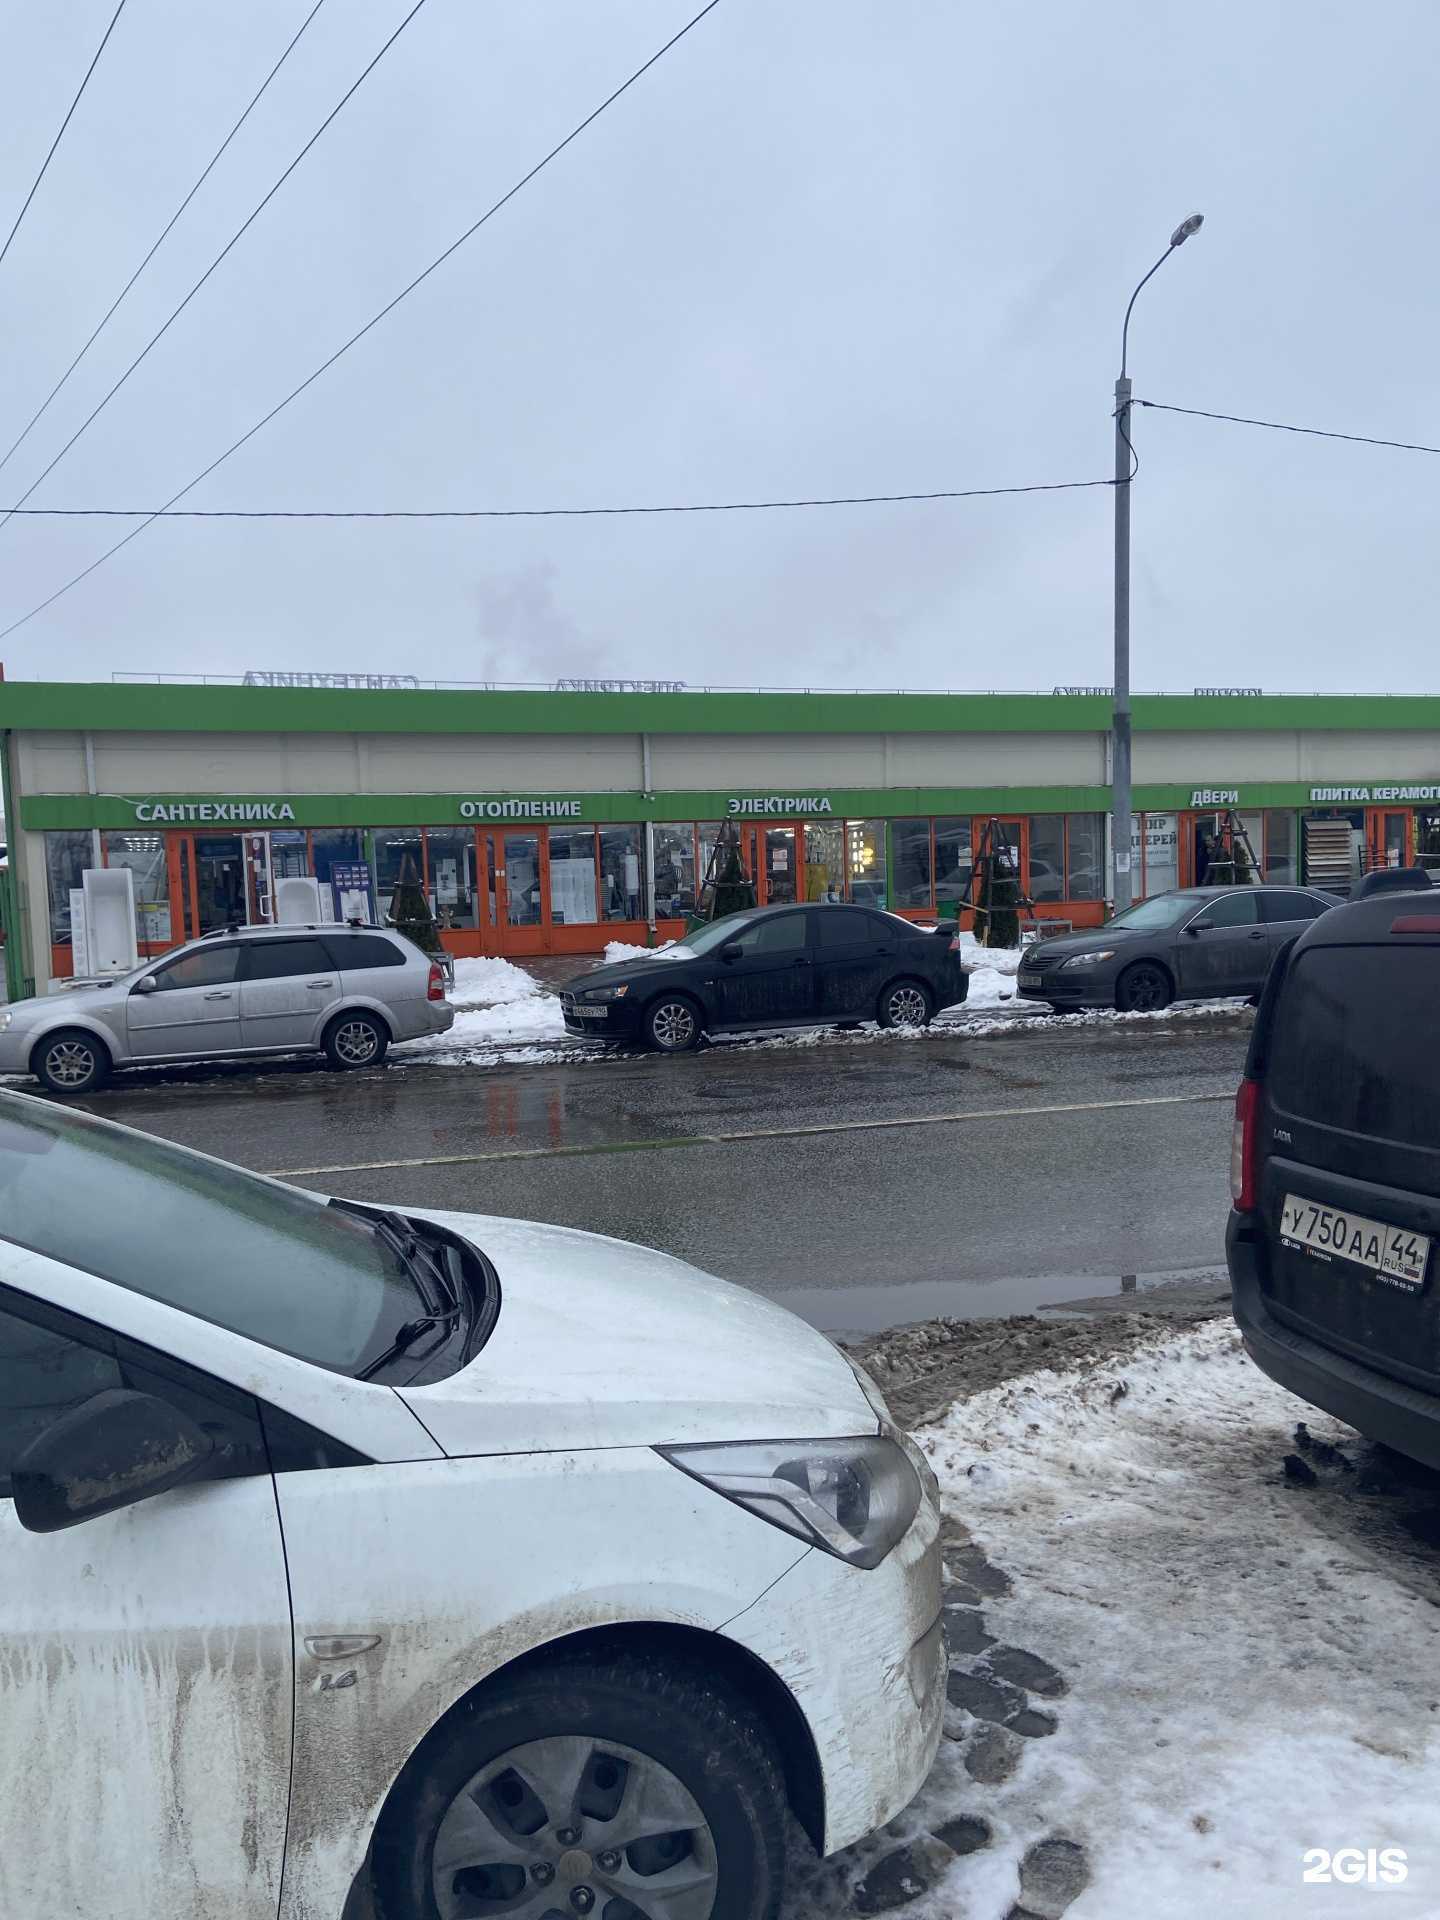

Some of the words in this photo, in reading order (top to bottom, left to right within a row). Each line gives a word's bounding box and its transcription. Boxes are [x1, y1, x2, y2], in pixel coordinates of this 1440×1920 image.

[1190, 788, 1239, 807] ДВЕРИ
[1310, 786, 1369, 802] ПЛИТКА
[136, 802, 295, 821] САНТЕХНИКА
[460, 799, 581, 818] ОТОПЛЕНИЕ
[728, 796, 832, 814] ЭЛЕКТРИКА
[1390, 1233, 1418, 1265] 44
[1383, 1257, 1405, 1273] RUS
